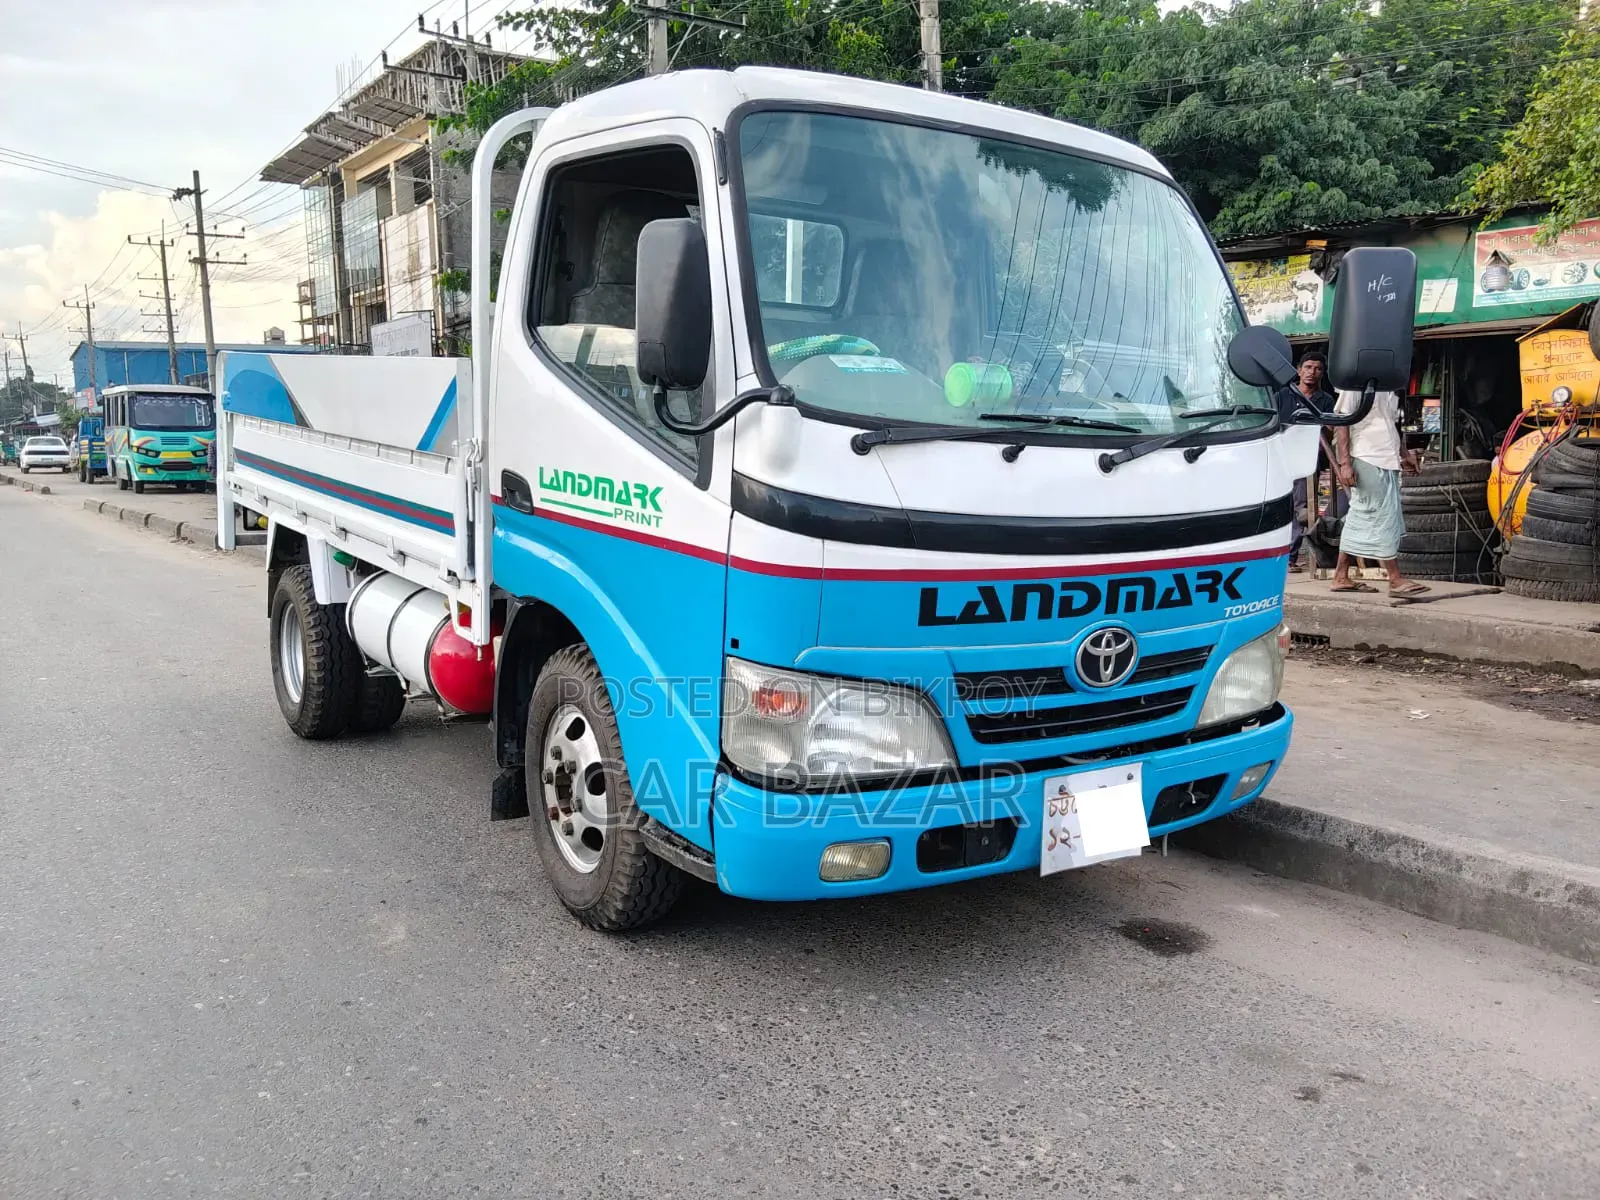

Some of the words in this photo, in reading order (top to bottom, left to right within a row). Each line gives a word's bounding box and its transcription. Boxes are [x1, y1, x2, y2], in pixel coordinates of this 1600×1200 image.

[1524, 372, 1551, 385] আবার
[538, 466, 664, 512] LANDMARK
[613, 507, 663, 528] PRINT
[917, 566, 1247, 627] LANDMARK
[1223, 594, 1281, 618] TOYOACE
